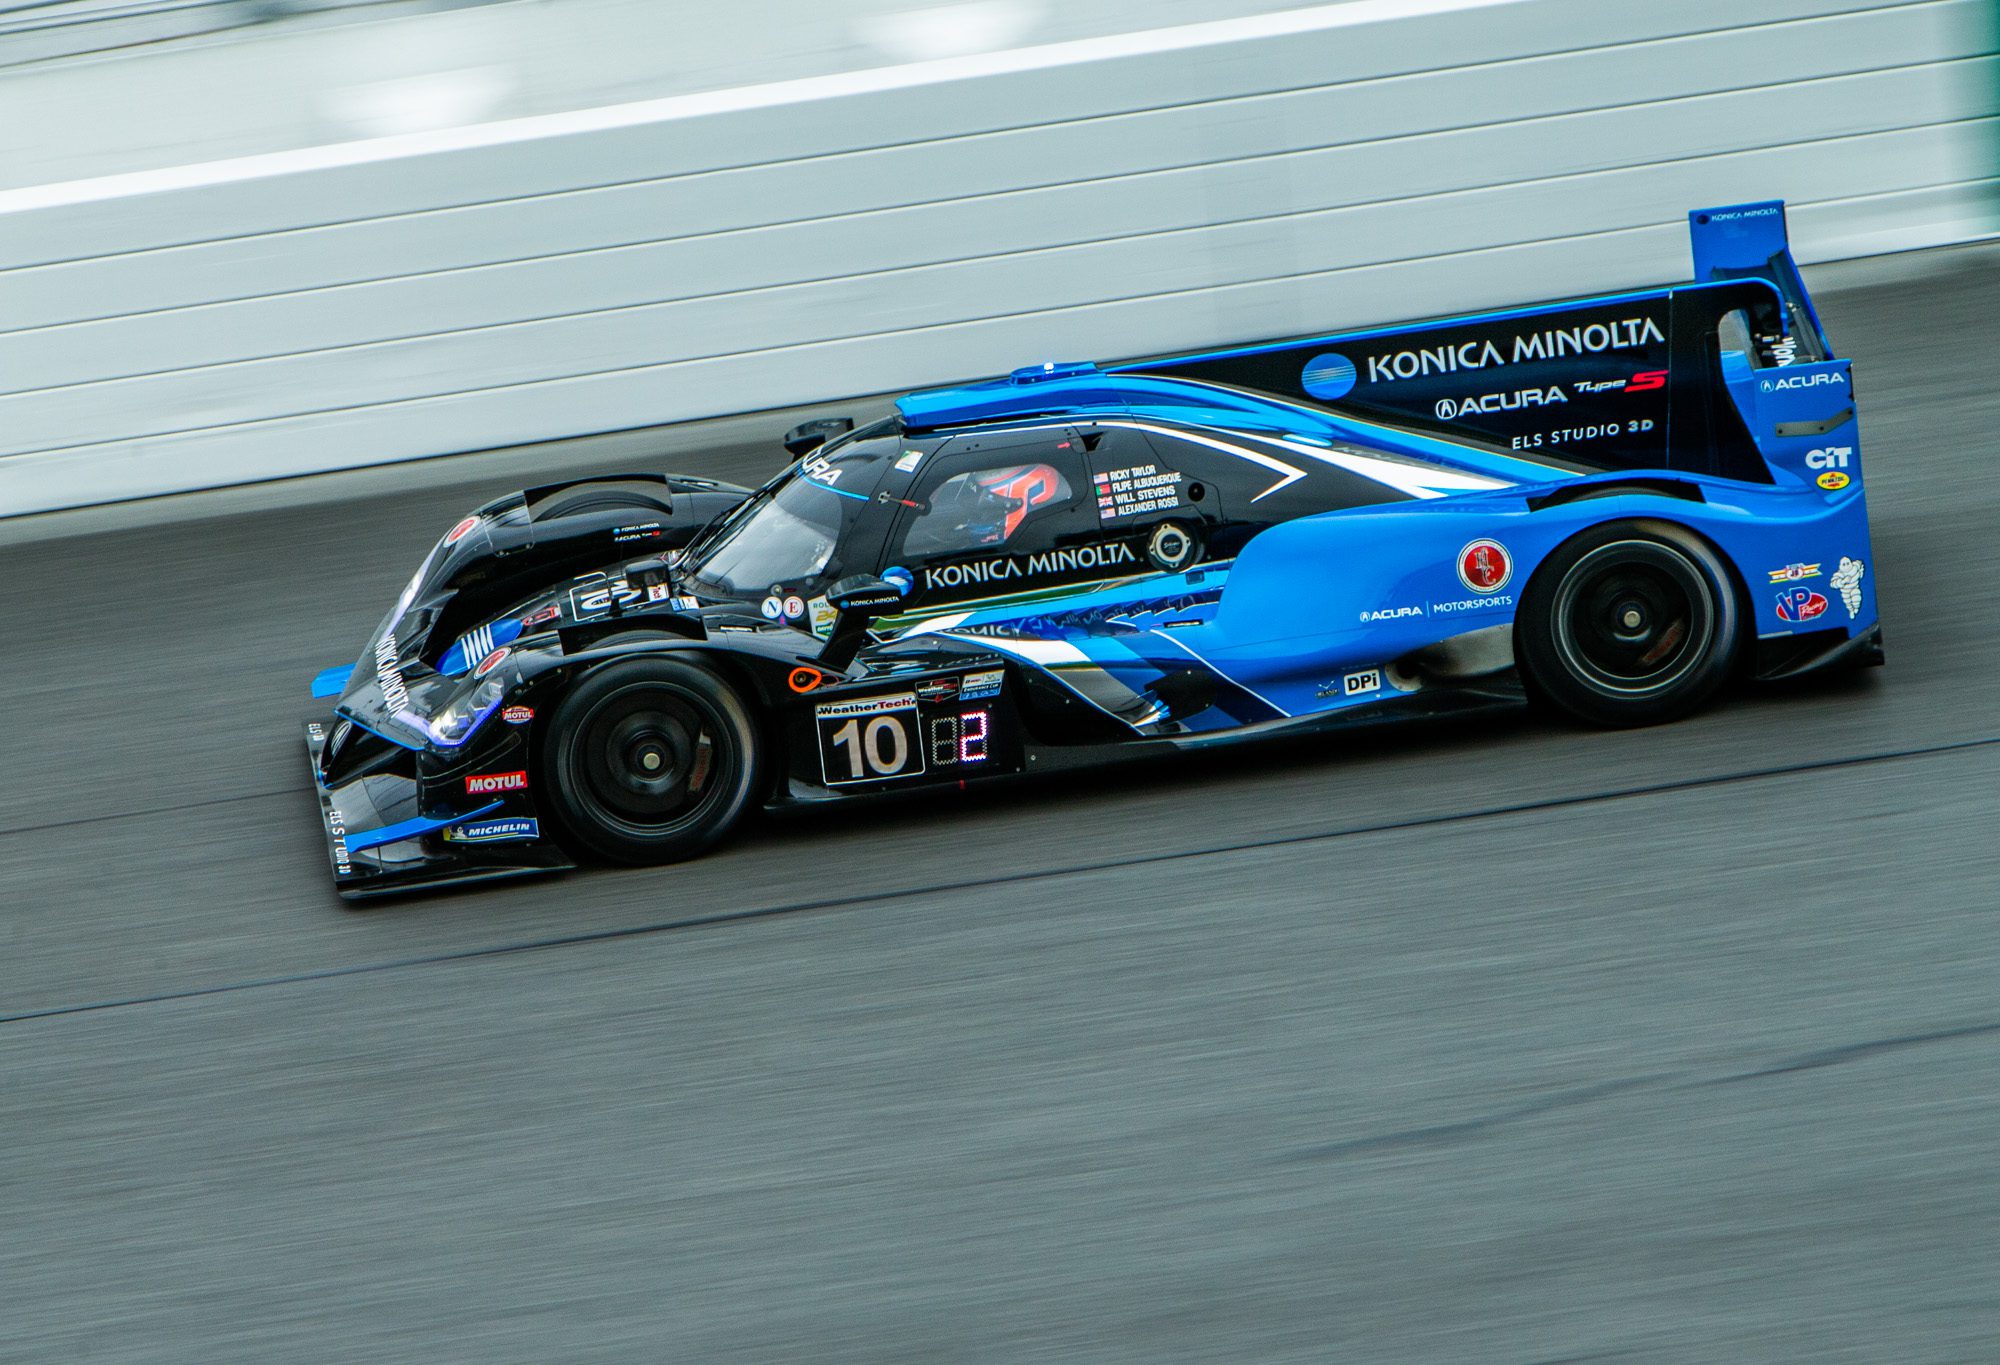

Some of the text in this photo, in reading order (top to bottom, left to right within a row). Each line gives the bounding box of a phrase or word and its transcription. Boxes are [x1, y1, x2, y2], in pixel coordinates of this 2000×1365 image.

[1711, 207, 1778, 222] KONICA MINOLTA
[1367, 317, 1665, 383] KONICA MINOLTA
[1775, 372, 1845, 391] ACURA
[1458, 369, 1669, 417] ACURA Type S
[1511, 419, 1655, 451] ELS STUDIO 3D
[1109, 464, 1157, 482] RICKY TAYLOR
[1112, 480, 1133, 493] FILIPE
[1115, 485, 1176, 505] WILL STEVENS
[1118, 496, 1179, 516] ALEXANDER ROSSI
[926, 558, 1023, 590] KONICA
[1027, 542, 1136, 576] MINOLTA
[766, 601, 799, 614] N E
[812, 601, 829, 609] ROL
[850, 596, 900, 607] KONICA MINOLTA
[1371, 595, 1513, 621] ACURA MOTORSPORTS
[1776, 587, 1811, 620] VP
[1347, 673, 1378, 692] DPi
[377, 668, 409, 719] MINOLTA
[503, 711, 532, 721] MOTUL
[821, 697, 914, 716] WeatherTech
[960, 711, 988, 762] 2
[833, 715, 908, 778] 10
[469, 774, 525, 792] MOTUL
[329, 810, 343, 825] ELS
[468, 823, 530, 837] MICHELIN
[331, 827, 350, 865] STUDIO
